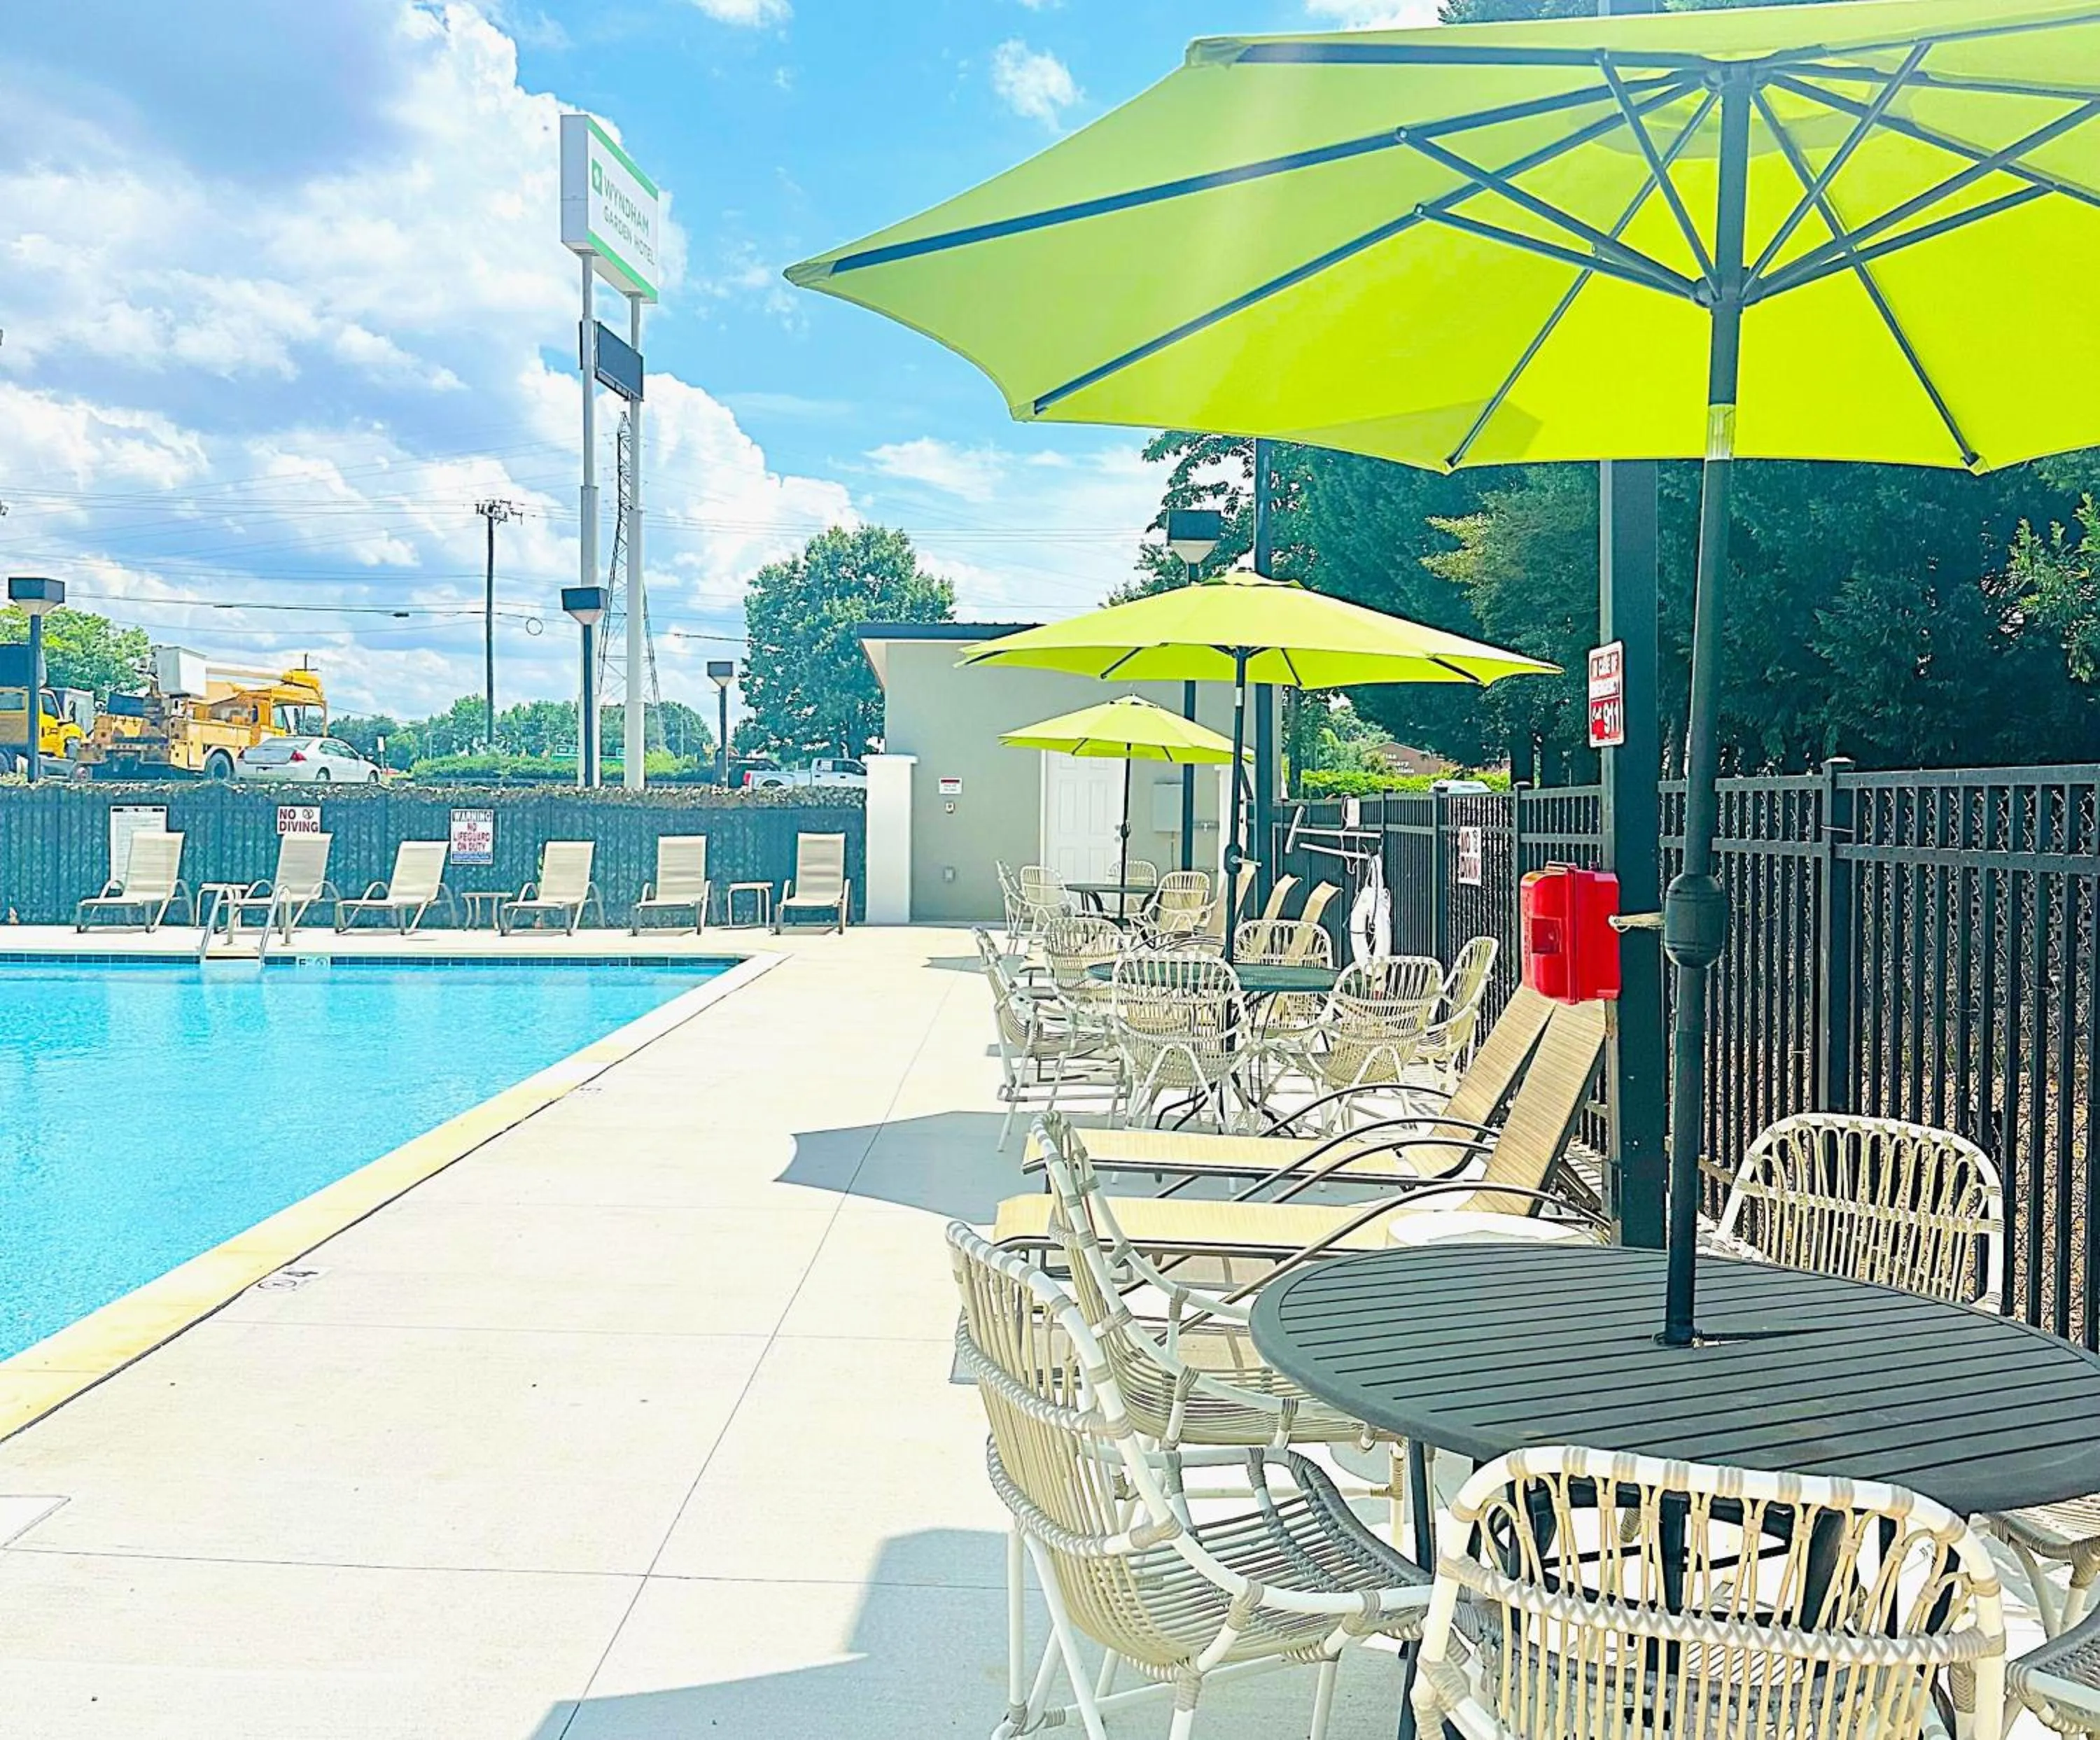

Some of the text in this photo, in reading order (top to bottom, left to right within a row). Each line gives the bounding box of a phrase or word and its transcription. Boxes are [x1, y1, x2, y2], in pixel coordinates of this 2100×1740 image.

[604, 176, 649, 237] WYNDHAM
[604, 205, 654, 265] GARDEN HOTEL
[279, 808, 296, 820] NO
[452, 811, 492, 822] WARNING
[279, 820, 318, 832] DIVING
[467, 822, 477, 832] NO
[454, 832, 490, 842] LIFEGUARD
[458, 842, 466, 851] ON
